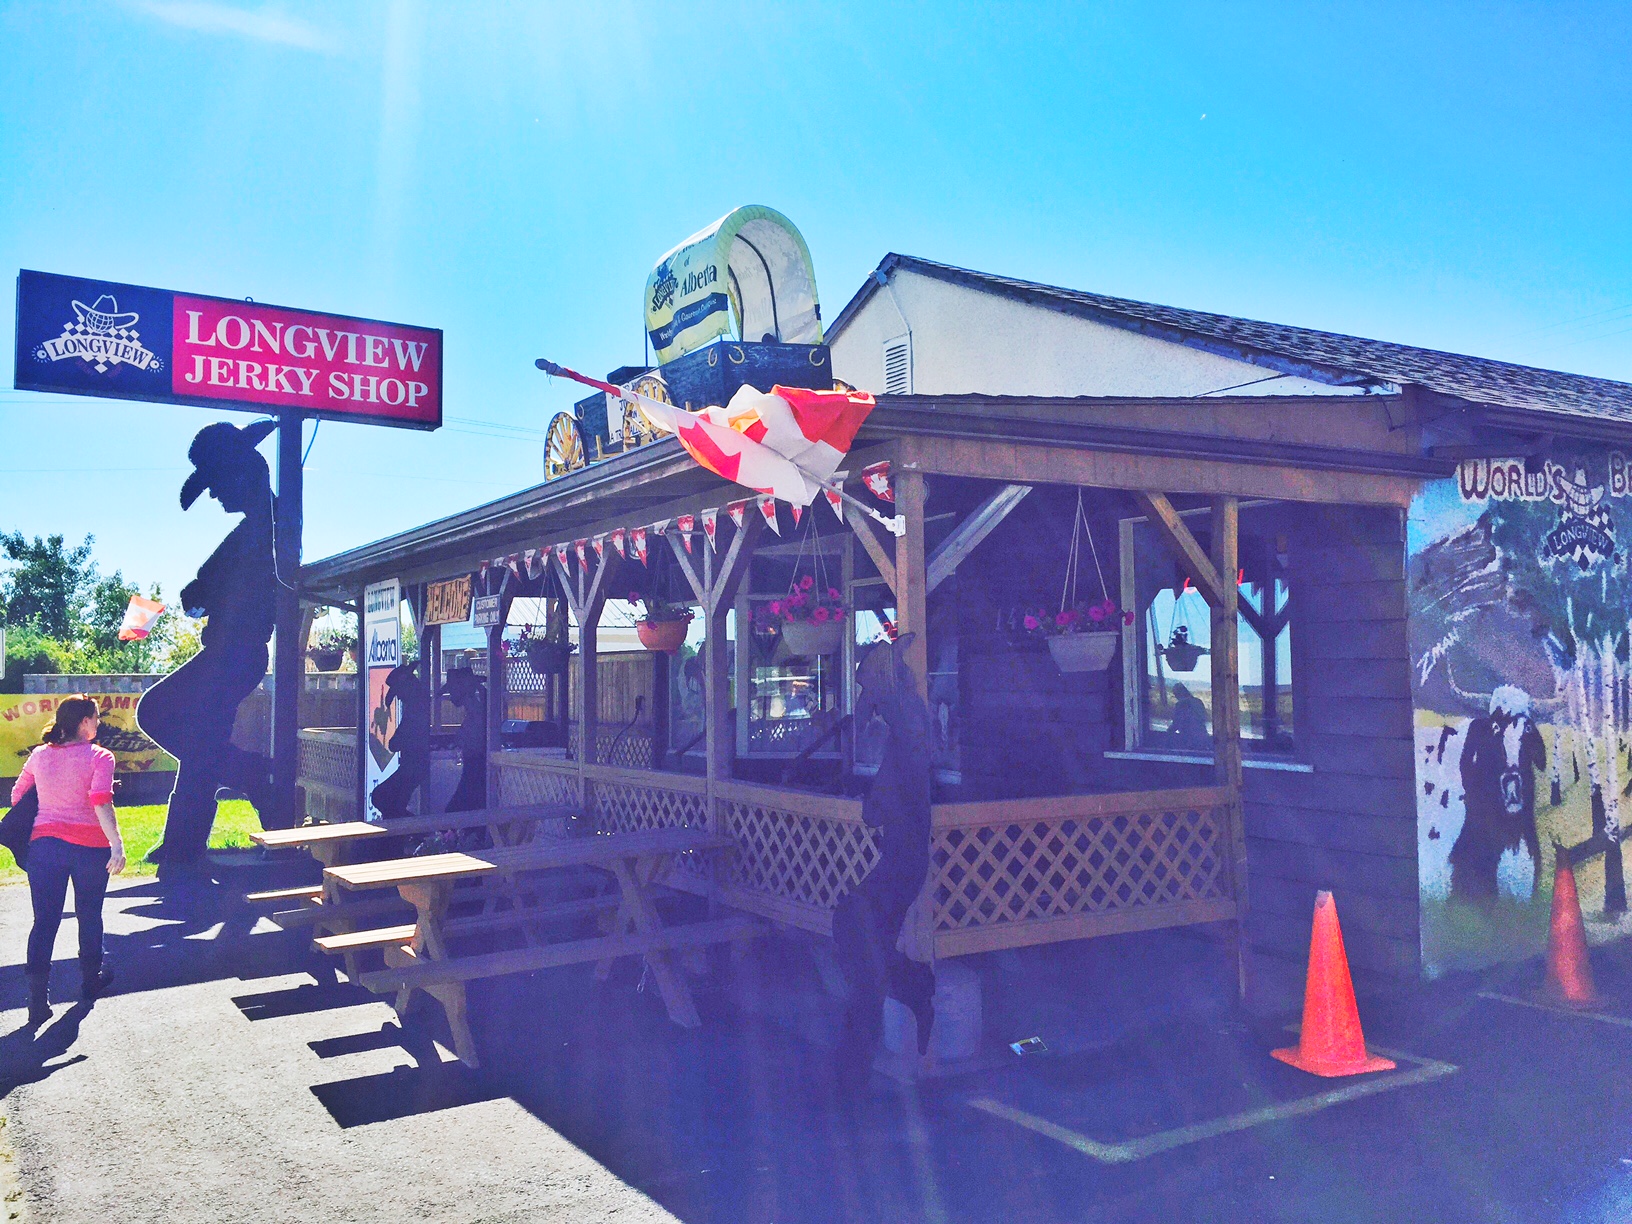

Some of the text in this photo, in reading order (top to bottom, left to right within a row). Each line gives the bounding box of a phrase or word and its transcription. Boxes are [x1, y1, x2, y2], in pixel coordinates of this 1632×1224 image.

[680, 264, 717, 297] Alberta
[50, 338, 149, 366] LONGVIEW
[185, 310, 428, 373] LONGVIEW
[185, 355, 429, 408] JERKY SHOP
[1552, 524, 1609, 550] LONGVIEW
[427, 579, 470, 622] WELCOME
[476, 597, 498, 610] CUSTOMER
[368, 628, 396, 662] Alberta
